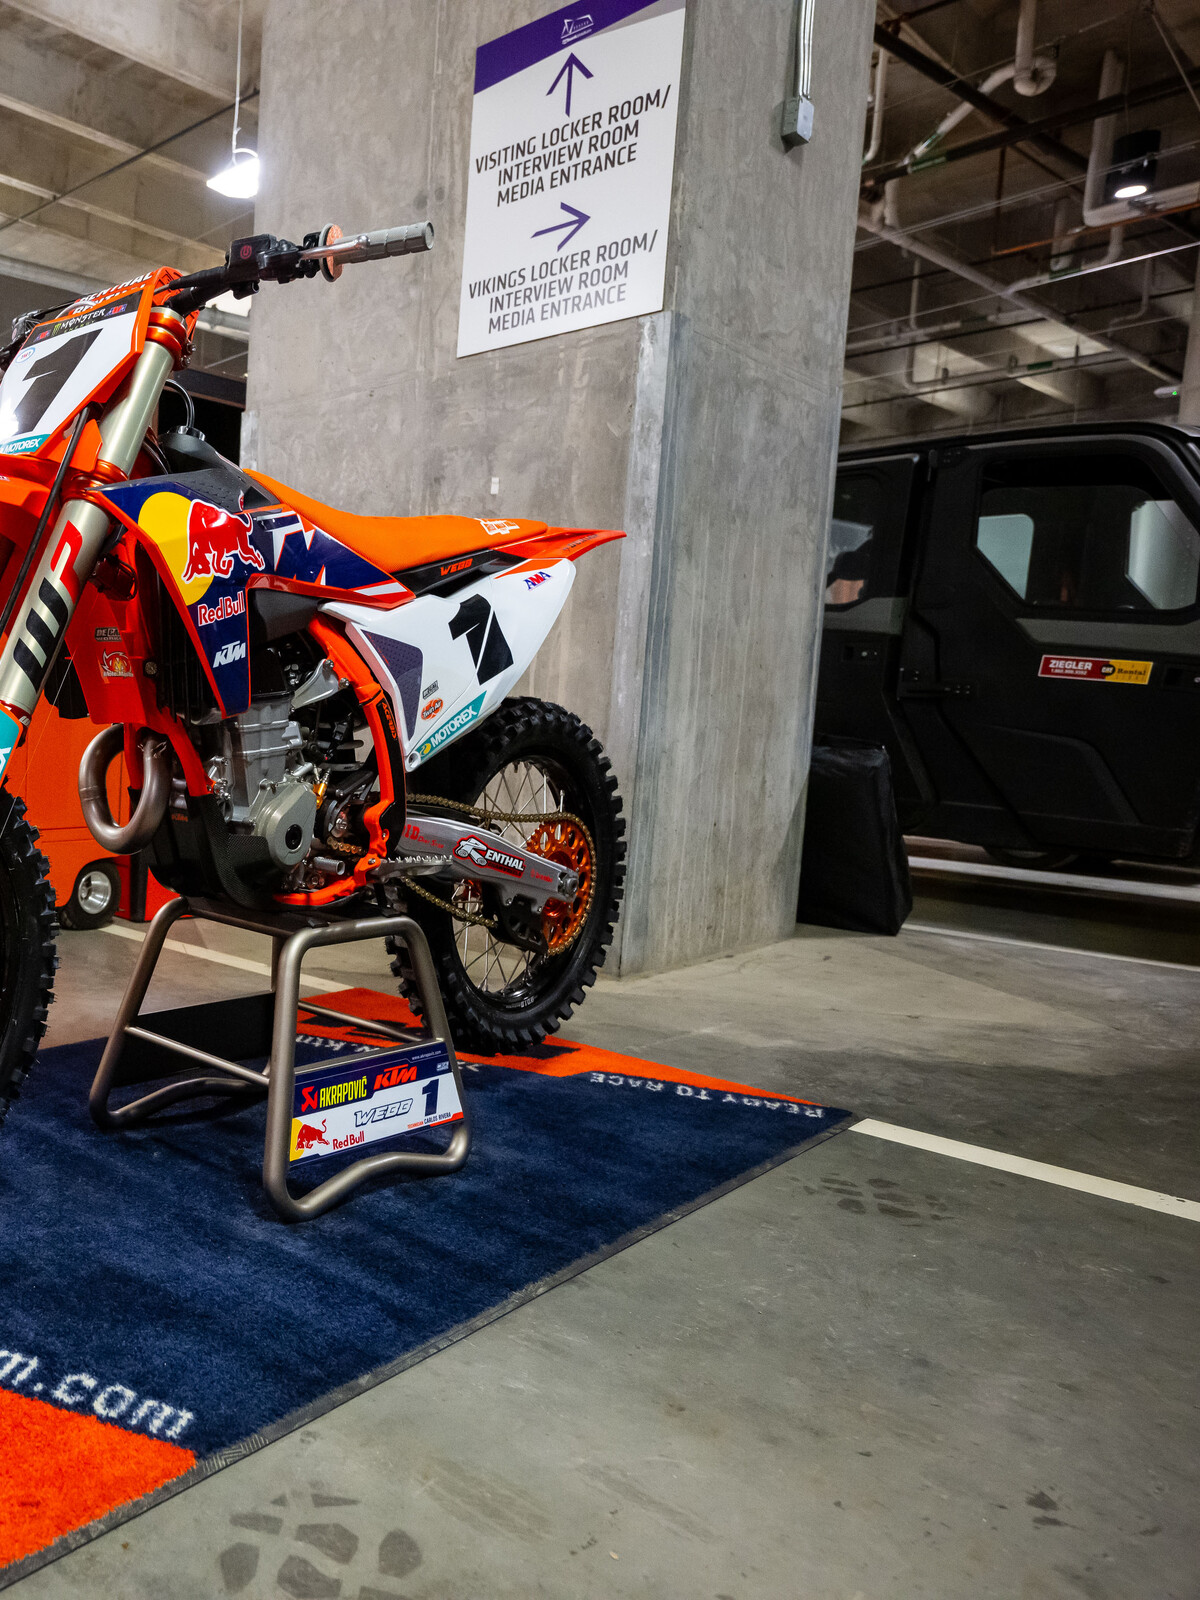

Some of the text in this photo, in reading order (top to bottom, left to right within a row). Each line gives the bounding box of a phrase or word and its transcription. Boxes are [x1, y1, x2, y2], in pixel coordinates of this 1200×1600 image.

[476, 84, 671, 174] VISITING LOCKER ROOM/
[498, 120, 640, 186] INTERVIEW ROOM
[497, 143, 638, 207] MEDIA ENTRANCE
[469, 230, 658, 300] VIKINGS LOCKER ROOM/
[489, 261, 628, 314] INTERVIEW ROOM
[488, 283, 627, 334] MEDIA ENTRANCE
[440, 558, 473, 576] WEBB
[523, 571, 552, 590] AMA
[198, 590, 246, 626] Red Bull
[212, 640, 246, 668] KTM
[448, 593, 514, 686] 1
[1049, 660, 1092, 670] ZIEGLER
[422, 706, 434, 719] Twin
[430, 706, 478, 748] MOTOREX
[319, 1064, 418, 1108] AKRAPOVIČ KTM
[590, 1072, 665, 1092] RACE
[676, 1085, 712, 1101] TO
[354, 1078, 440, 1128] WEBB 1
[424, 1115, 438, 1125] CARLOS
[438, 1112, 451, 1120] RIVERA
[332, 1130, 364, 1150] Red Bull
